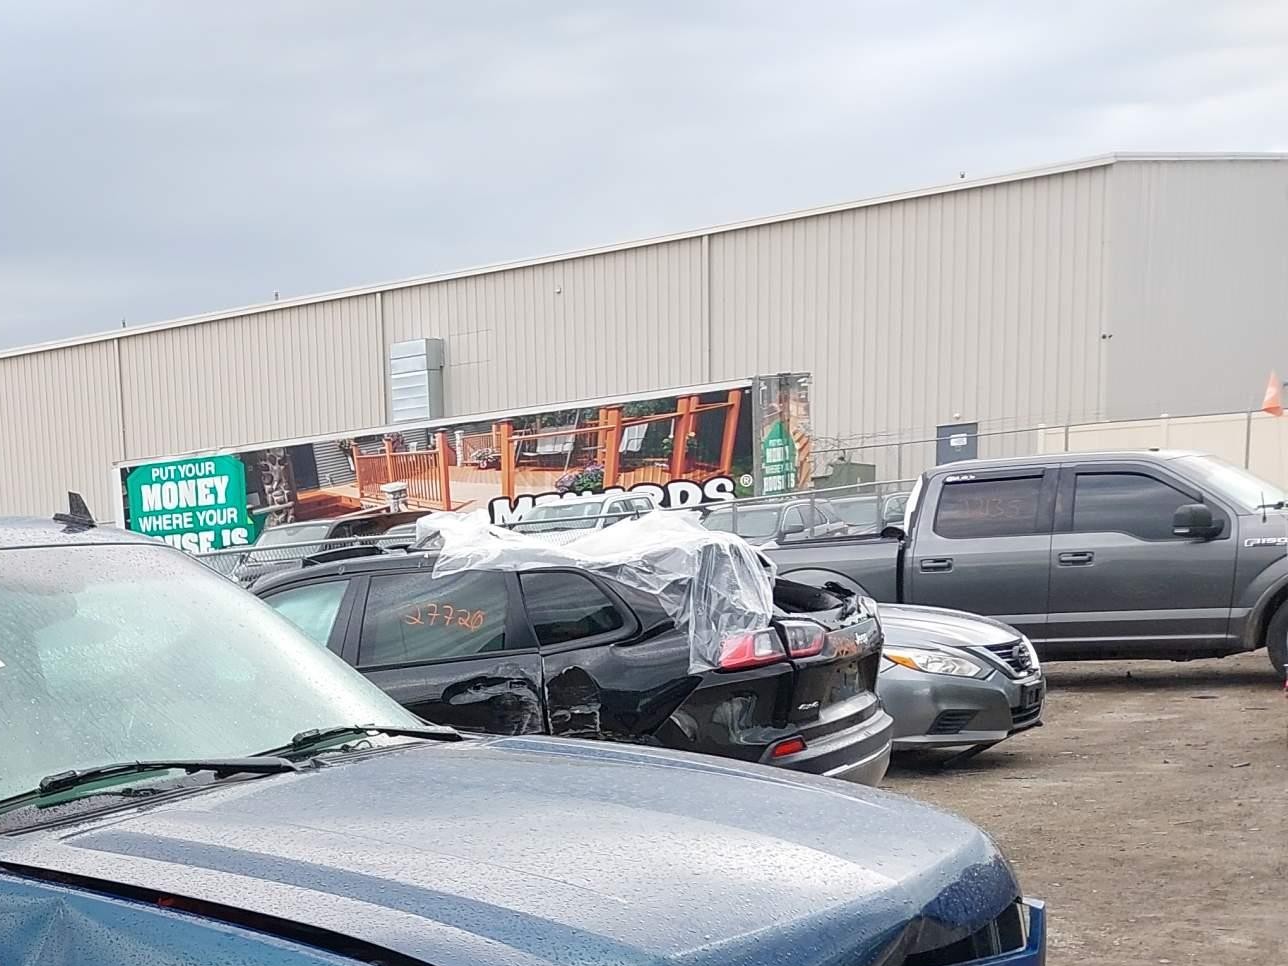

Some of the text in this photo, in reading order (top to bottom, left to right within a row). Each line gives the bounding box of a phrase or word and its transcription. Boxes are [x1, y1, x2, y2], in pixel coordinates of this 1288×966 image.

[151, 462, 216, 481] PUT YOUR
[140, 475, 229, 512] MONEY
[138, 508, 238, 532] WHERE YOUR
[404, 602, 484, 630] 27720
